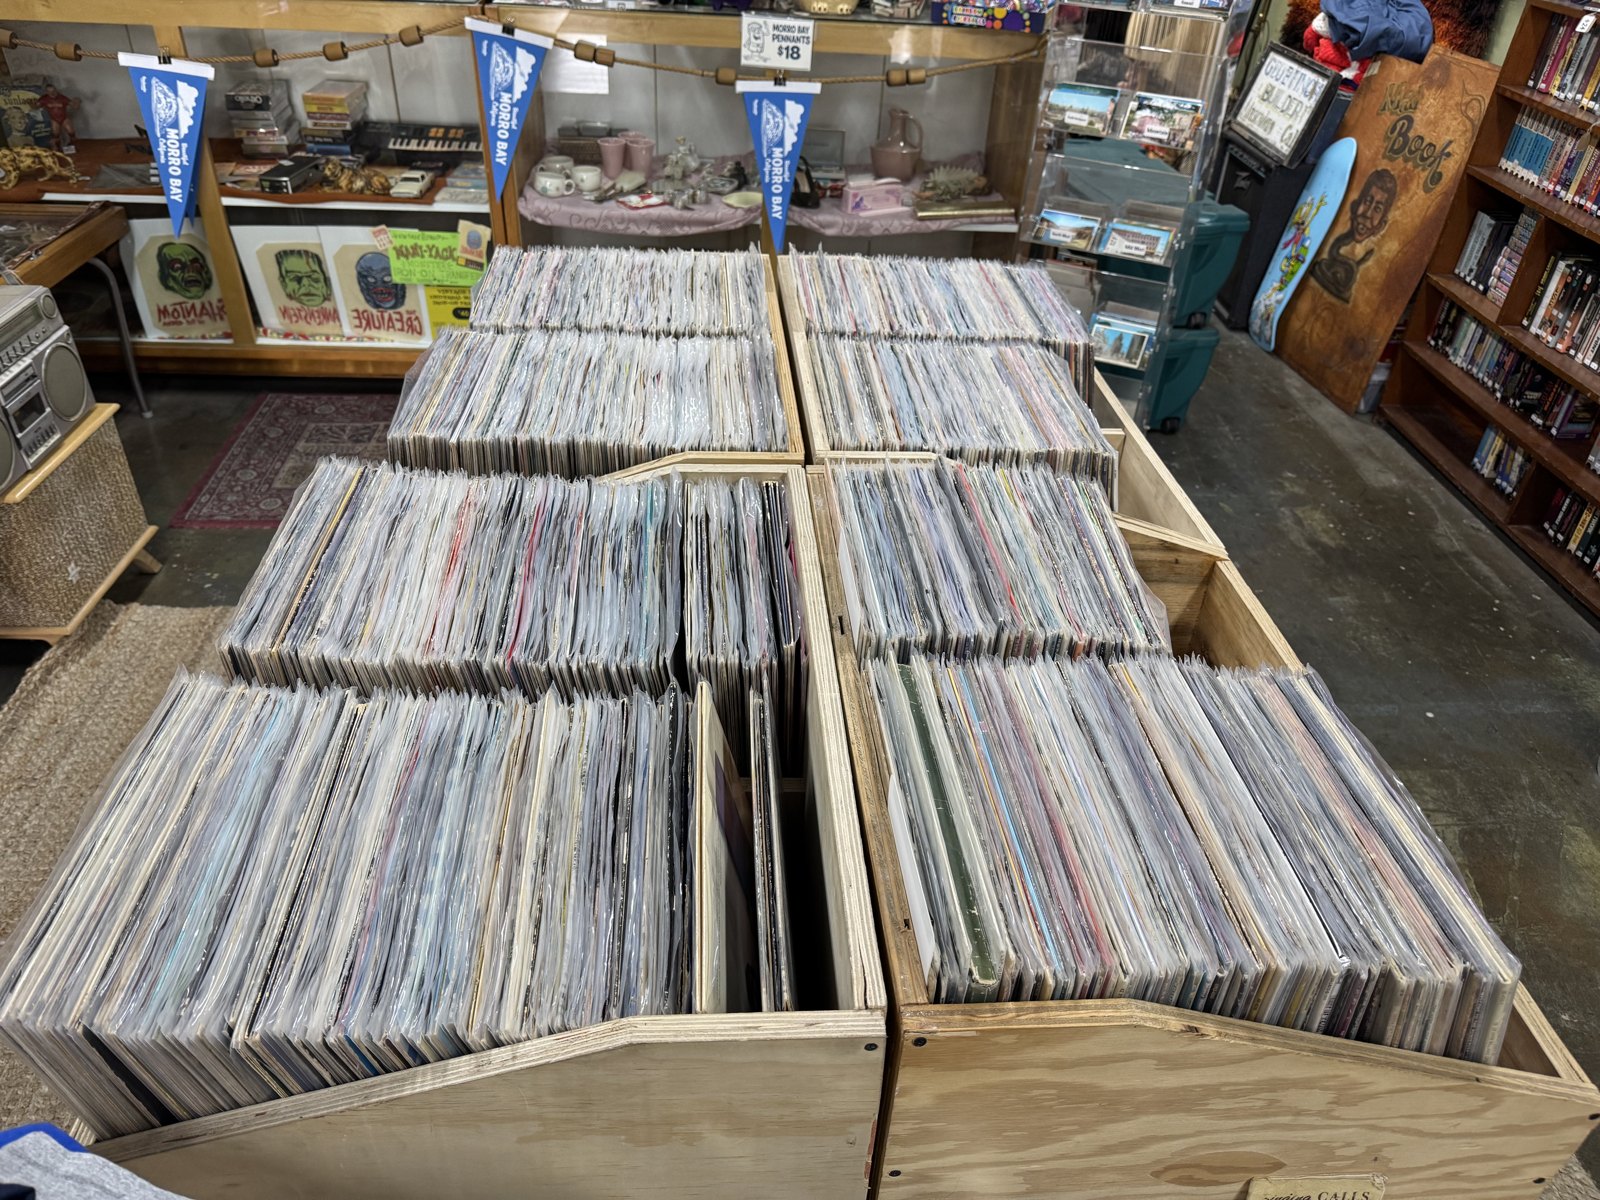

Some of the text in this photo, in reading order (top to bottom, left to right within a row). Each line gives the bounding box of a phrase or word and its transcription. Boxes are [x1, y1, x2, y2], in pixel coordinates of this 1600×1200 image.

[772, 24, 810, 34] MORRO BAY
[772, 34, 810, 45] PENNANTS
[777, 45, 801, 60] $18
[496, 91, 512, 166] MORRO BAY
[157, 137, 166, 164] California
[1384, 114, 1454, 191] Book
[165, 127, 183, 203] MORRO BAY
[763, 158, 771, 184] California
[771, 147, 783, 220] MORRO BAY
